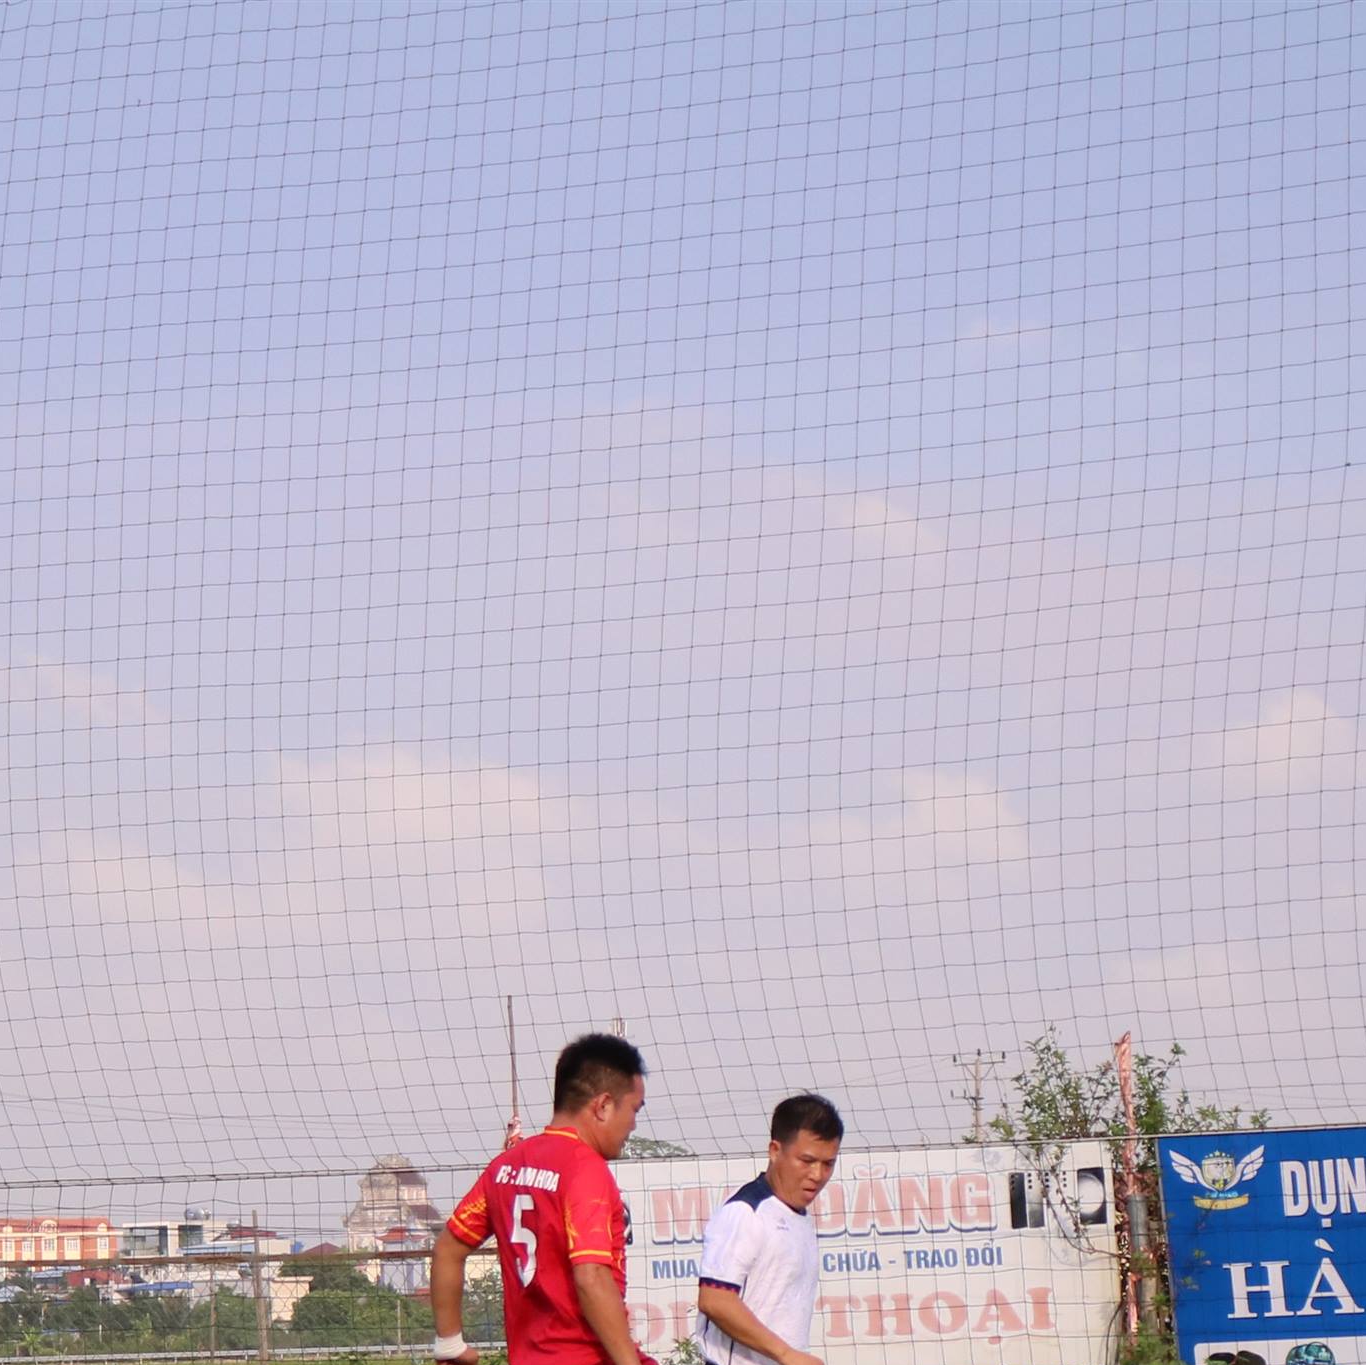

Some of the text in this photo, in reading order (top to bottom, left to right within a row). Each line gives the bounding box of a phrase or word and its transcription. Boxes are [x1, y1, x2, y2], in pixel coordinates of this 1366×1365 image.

[511, 1194, 537, 1288] 5
[652, 1259, 700, 1279] MUA
[903, 1248, 958, 1270] TRAO
[965, 1239, 1003, 1267] ĐỔI
[1222, 1238, 1365, 1319] HÀ
[815, 1287, 1056, 1345] THOẠI
